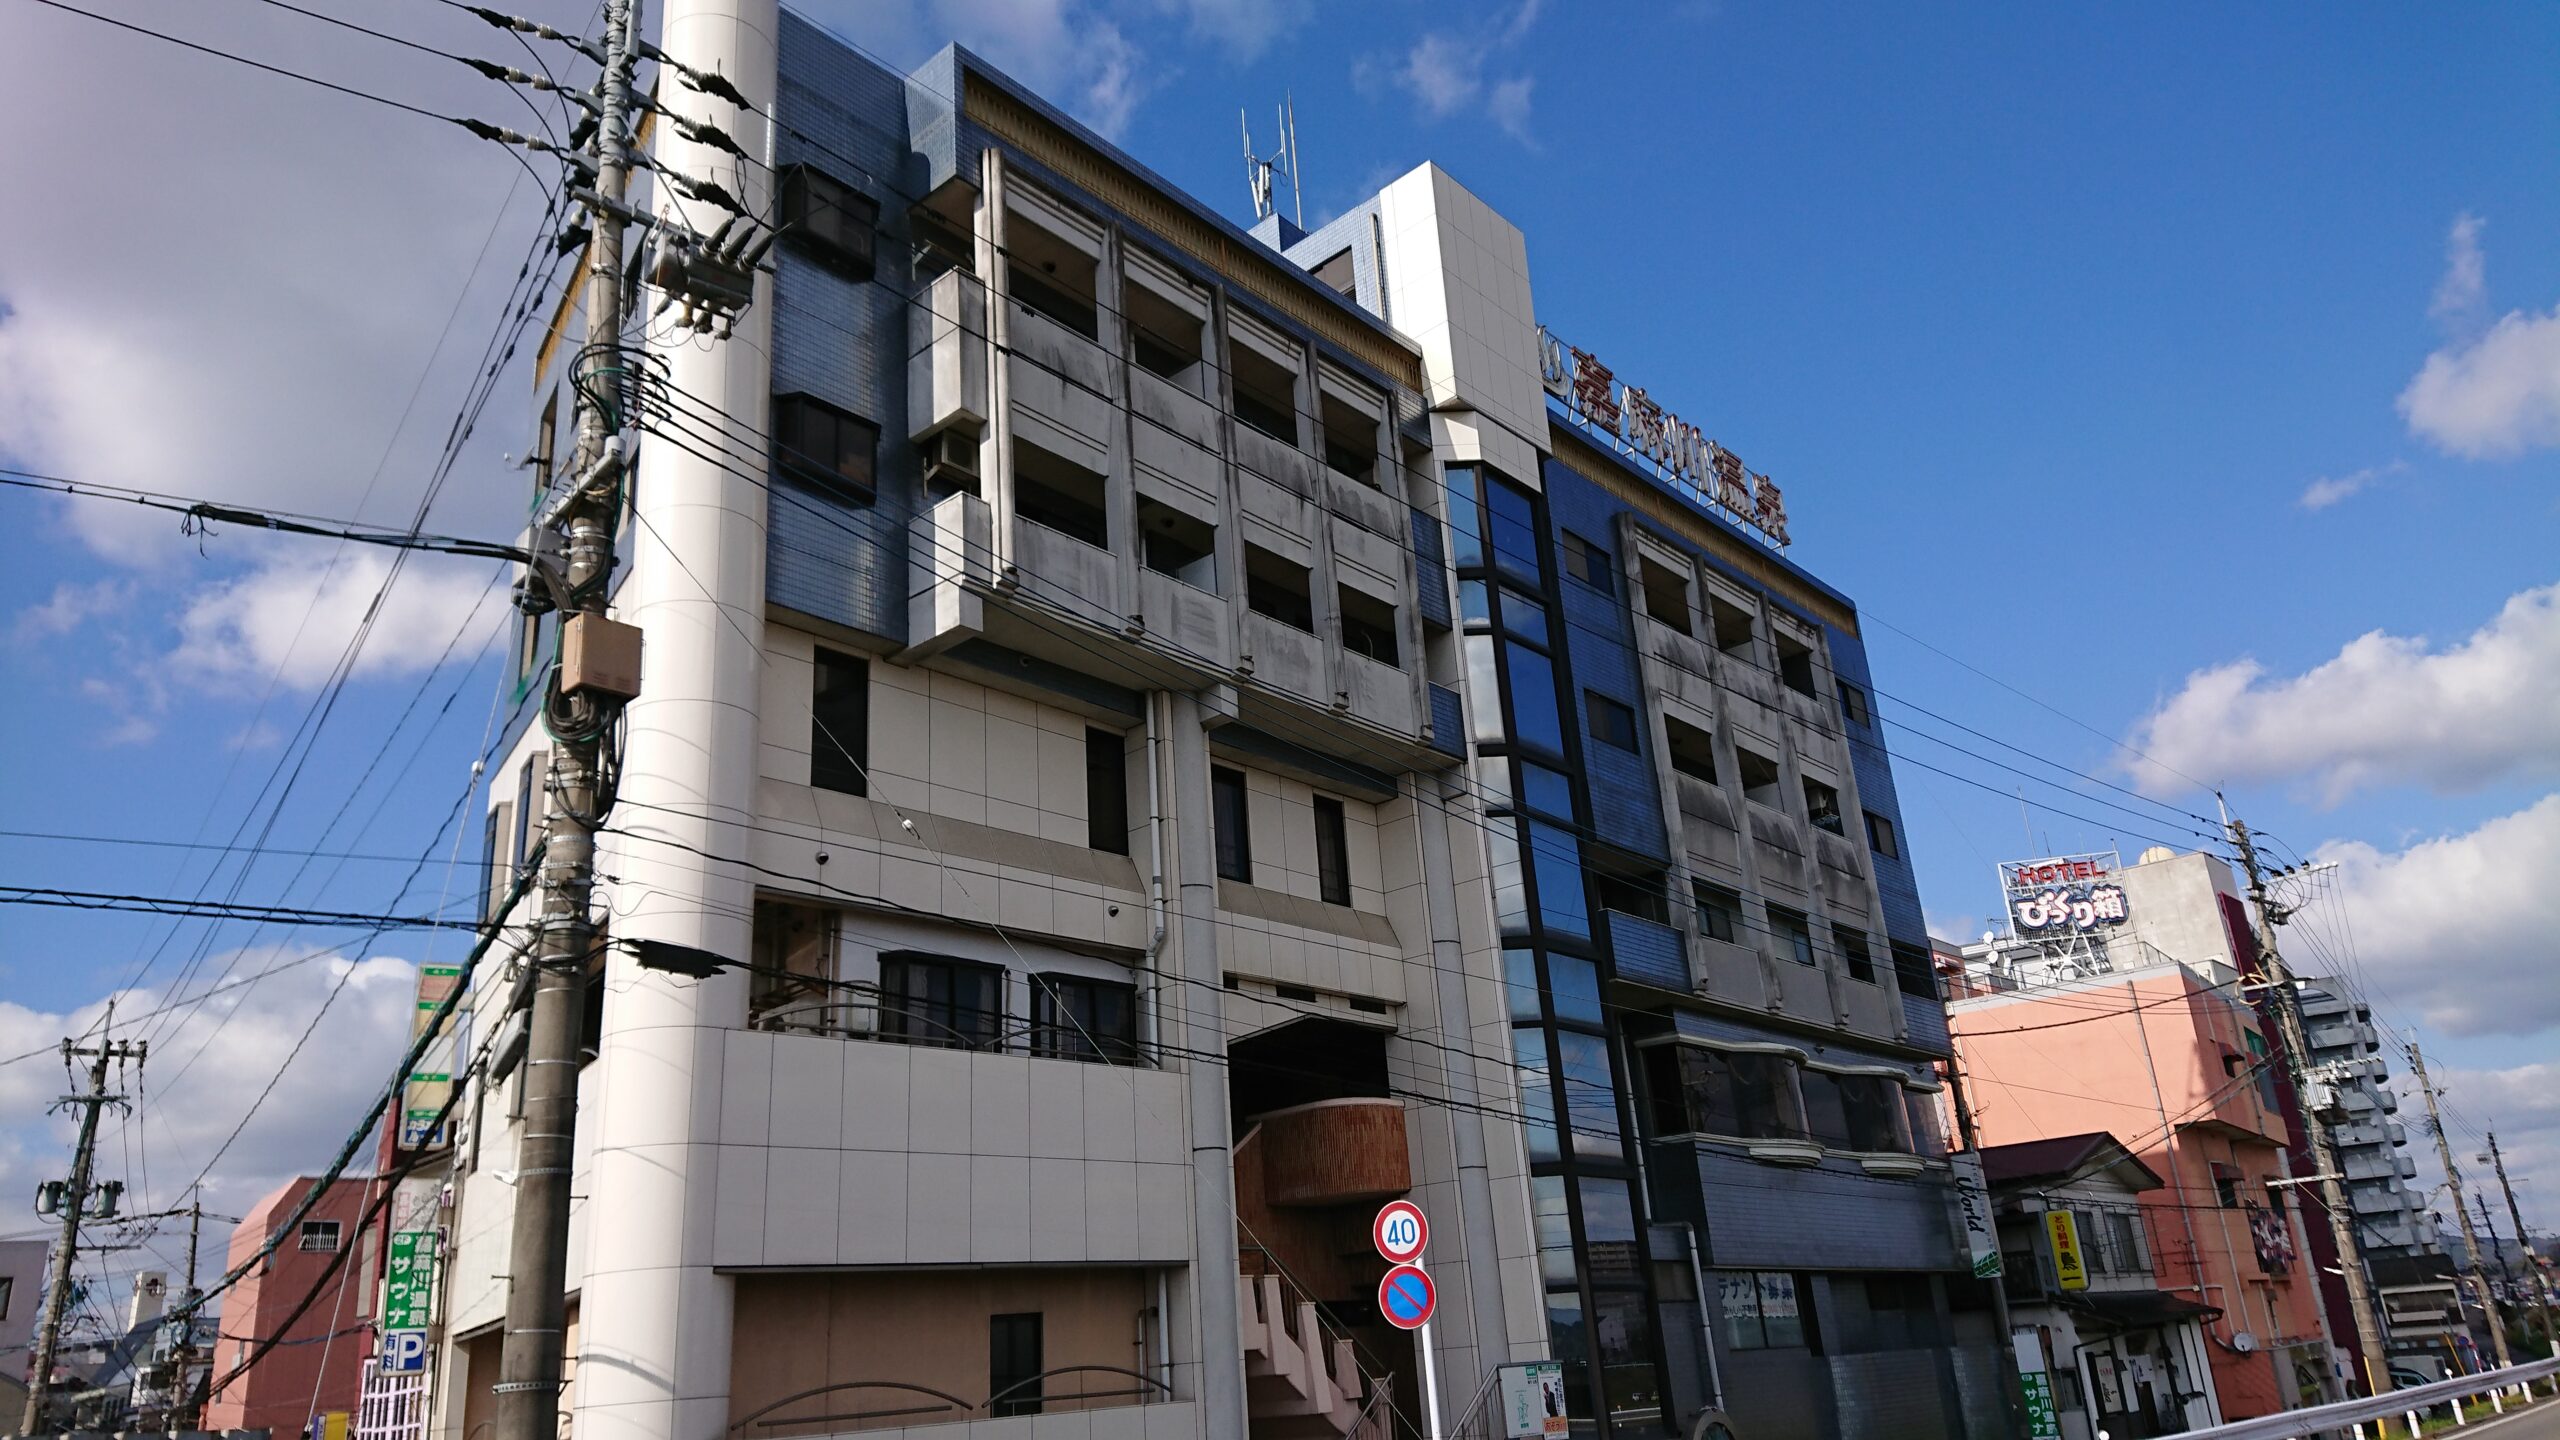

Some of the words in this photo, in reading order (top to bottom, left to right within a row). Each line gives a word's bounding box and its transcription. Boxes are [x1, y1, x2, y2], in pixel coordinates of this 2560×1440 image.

[2018, 861, 2106, 885] HOTEL
[2015, 885, 2127, 929] びっくり箱
[1955, 1176, 1986, 1233] World
[1387, 1218, 1416, 1246] 40
[388, 1256, 411, 1325] サウナ
[382, 1331, 397, 1372] 有料
[398, 1333, 424, 1370] P
[2025, 1388, 2044, 1434] サウナ
